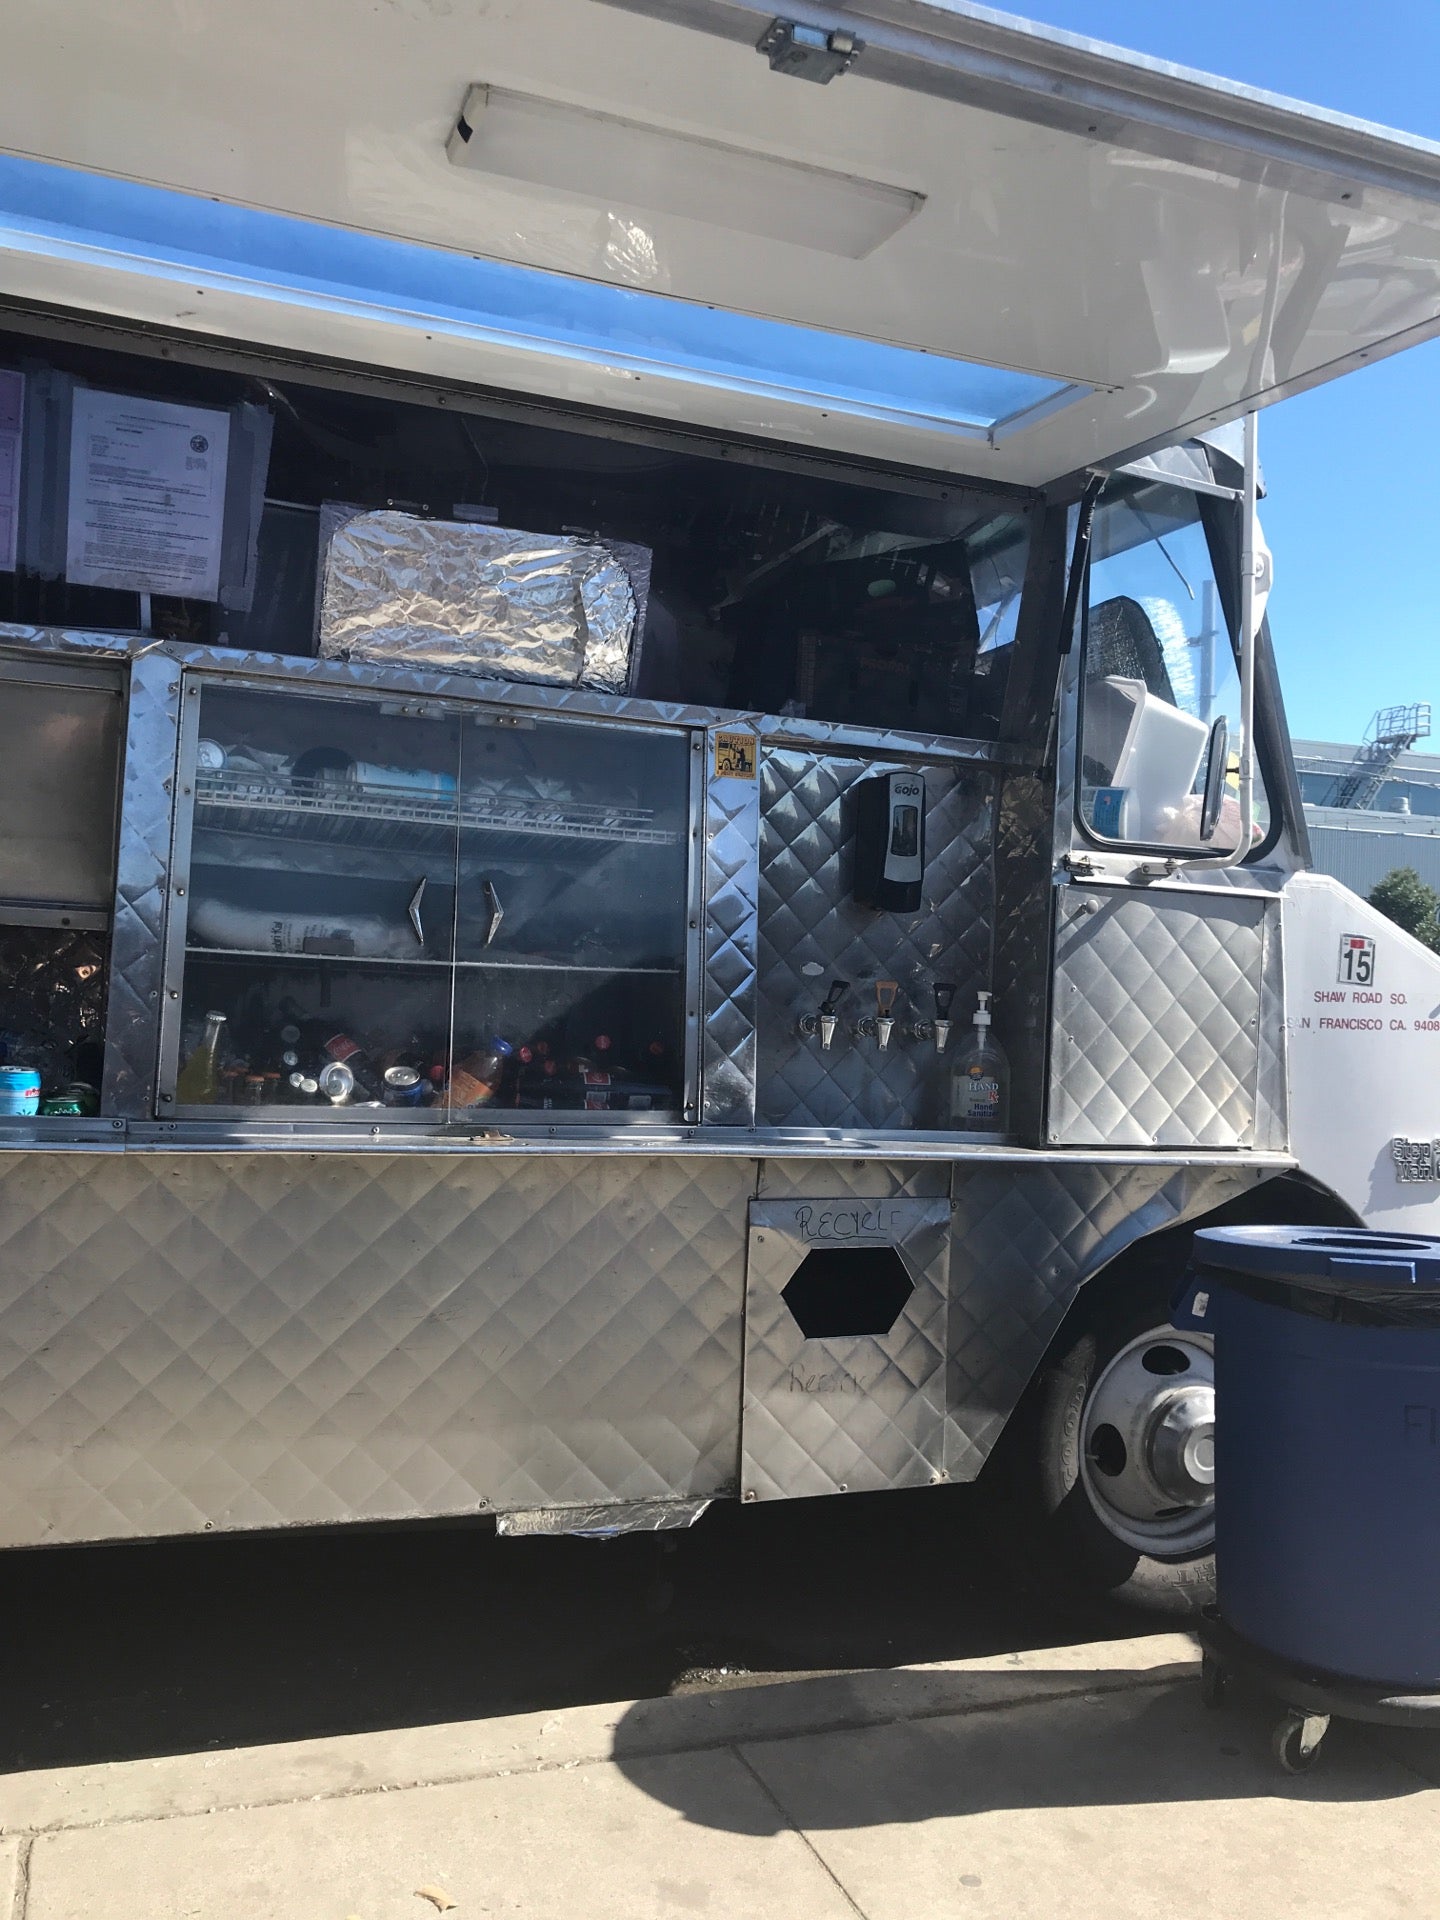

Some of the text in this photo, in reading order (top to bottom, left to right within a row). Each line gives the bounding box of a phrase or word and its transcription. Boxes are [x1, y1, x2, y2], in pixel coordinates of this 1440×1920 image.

[716, 733, 755, 745] CAUTION
[1343, 949, 1371, 982] 15
[1314, 991, 1407, 1005] SHAW ROAD SO.
[1319, 1018, 1383, 1030] FRANCISCO
[1390, 1020, 1406, 1031] CA.
[968, 1082, 1000, 1092] HAND
[974, 1103, 993, 1111] Hand
[968, 1110, 1000, 1118] Sanitizer
[1392, 1137, 1431, 1163] Step
[1398, 1160, 1432, 1181] Van
